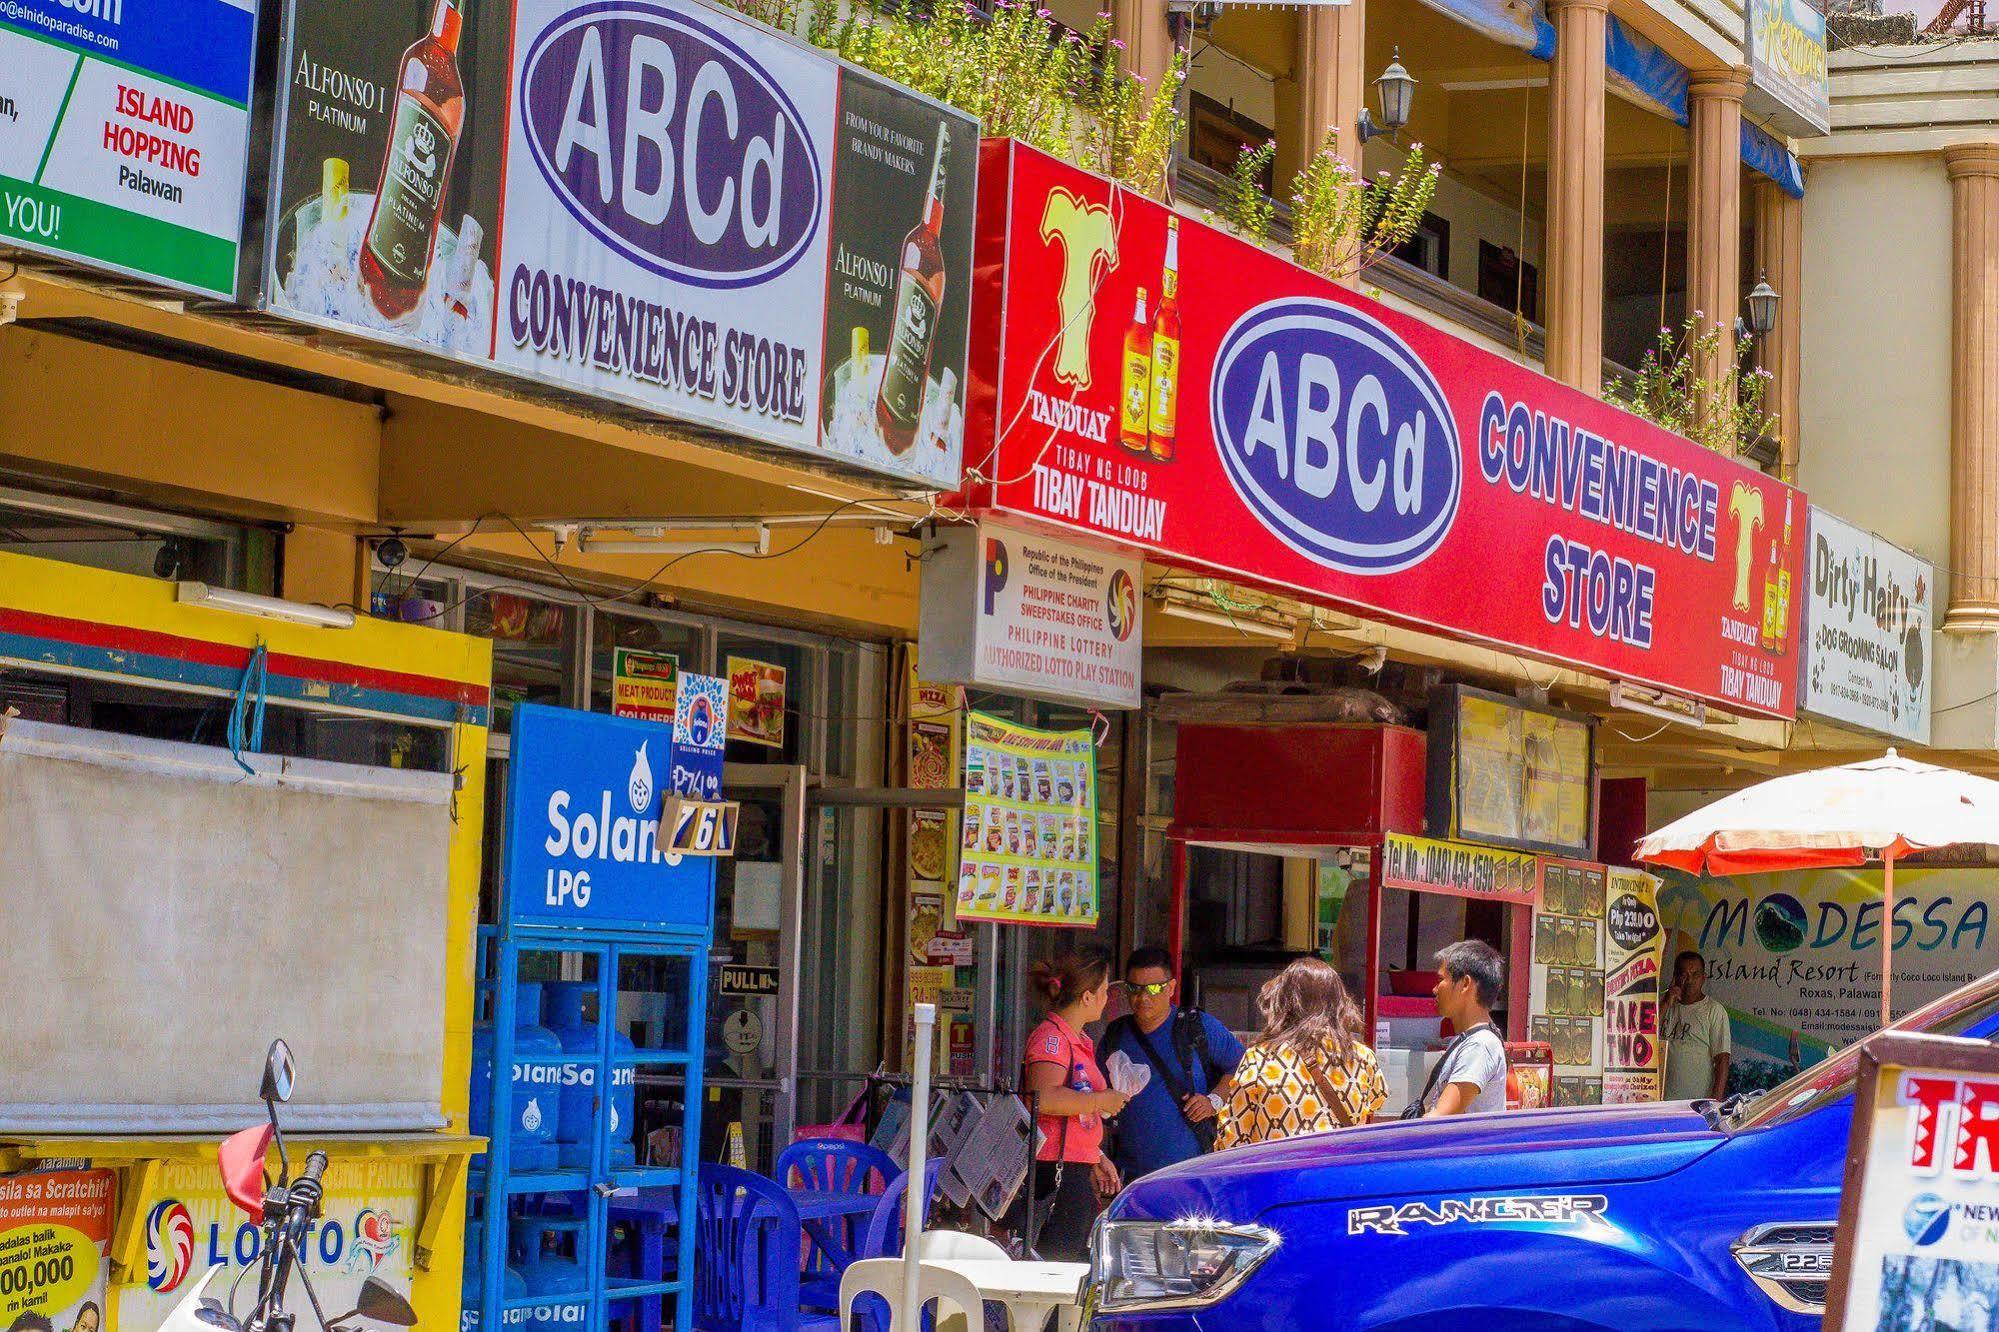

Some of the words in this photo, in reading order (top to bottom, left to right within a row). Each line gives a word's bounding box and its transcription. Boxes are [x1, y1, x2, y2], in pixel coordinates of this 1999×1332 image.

[295, 49, 376, 110] ALFONSO
[116, 84, 194, 134] ISLAND
[309, 100, 367, 135] PLATINUM
[103, 121, 200, 176] HOPPING
[556, 26, 785, 248] ABCd
[846, 111, 868, 134] FROM
[869, 119, 890, 143] YOUR
[890, 131, 925, 157] FAVORITE
[852, 137, 883, 163] BRANDY
[119, 165, 183, 203] Palawan
[5, 191, 60, 240] YOU!
[835, 243, 888, 288] ALFONSO
[844, 283, 882, 309] PLATINUM
[510, 263, 719, 399] CONVENIENCE
[723, 328, 807, 423] STORE
[1030, 390, 1112, 445] TANDUAY
[1244, 351, 1426, 516] ABCd
[1056, 445, 1090, 473] TIBAY
[1096, 458, 1114, 480] NG
[1117, 463, 1148, 491] LOOB
[1479, 391, 1720, 562] CONVENIENCE
[1034, 463, 1082, 520] TIBAY
[1088, 479, 1167, 542] TANDUAY
[1022, 546, 1050, 563] Republic
[1051, 554, 1059, 564] of
[1060, 555, 1070, 568] the
[1071, 557, 1104, 576] Philippines
[1028, 563, 1048, 578] Office
[1048, 569, 1056, 579] of
[1057, 570, 1067, 582] the
[1068, 572, 1098, 589] President
[1023, 585, 1066, 608] PHILIPPINE
[1067, 594, 1100, 613] CHARITY
[1542, 534, 1656, 650] STORE
[1816, 533, 1858, 624] Dirty
[1862, 555, 1909, 645] Hairy
[1020, 603, 1076, 626] SWEEPSTAKES
[1077, 615, 1103, 632] OFFICE
[1721, 616, 1758, 647] TANDUAY
[1008, 625, 1067, 650] PHILIPPINE
[1070, 637, 1114, 659] LOTTERY
[1821, 624, 1838, 651] DOG
[1838, 630, 1876, 664] GROOMING
[1875, 645, 1899, 673] SALON
[984, 644, 1043, 673] AUTHORIZED
[1044, 657, 1073, 679] LOTTO
[1075, 661, 1097, 682] PLAY
[1098, 665, 1135, 690] STATION
[618, 684, 640, 699] MEAT
[641, 686, 677, 702] PRODUCTS
[1721, 664, 1746, 700] TIBAY
[1746, 672, 1782, 710] TANDUAY
[1388, 839, 1404, 881] Tel.
[1452, 850, 1494, 893] 434-1598
[546, 868, 591, 908] LPG
[723, 971, 758, 990] PULL
[1706, 957, 1782, 988] Island
[1788, 958, 1859, 986] Resort
[1901, 973, 1922, 983] Coco
[1922, 973, 1941, 983] Loco
[1942, 973, 1961, 984] Island
[1788, 1007, 1813, 1018] (048)
[1814, 1008, 1857, 1018] 434-1584
[1800, 987, 1837, 1001] Roxas,
[1605, 1000, 1657, 1035] TAKE
[1606, 1033, 1654, 1067] TWO
[25, 1185, 42, 1200] sa
[45, 1177, 110, 1200] Scratchit!
[11, 1204, 36, 1218] outlet
[37, 1207, 48, 1217] na
[49, 1204, 81, 1221] malapit
[1347, 1195, 1615, 1236] RANGER
[32, 1229, 56, 1242] balik
[33, 1243, 74, 1259] Makaka-
[7, 1299, 20, 1312] rin
[21, 1292, 48, 1309] kami!
